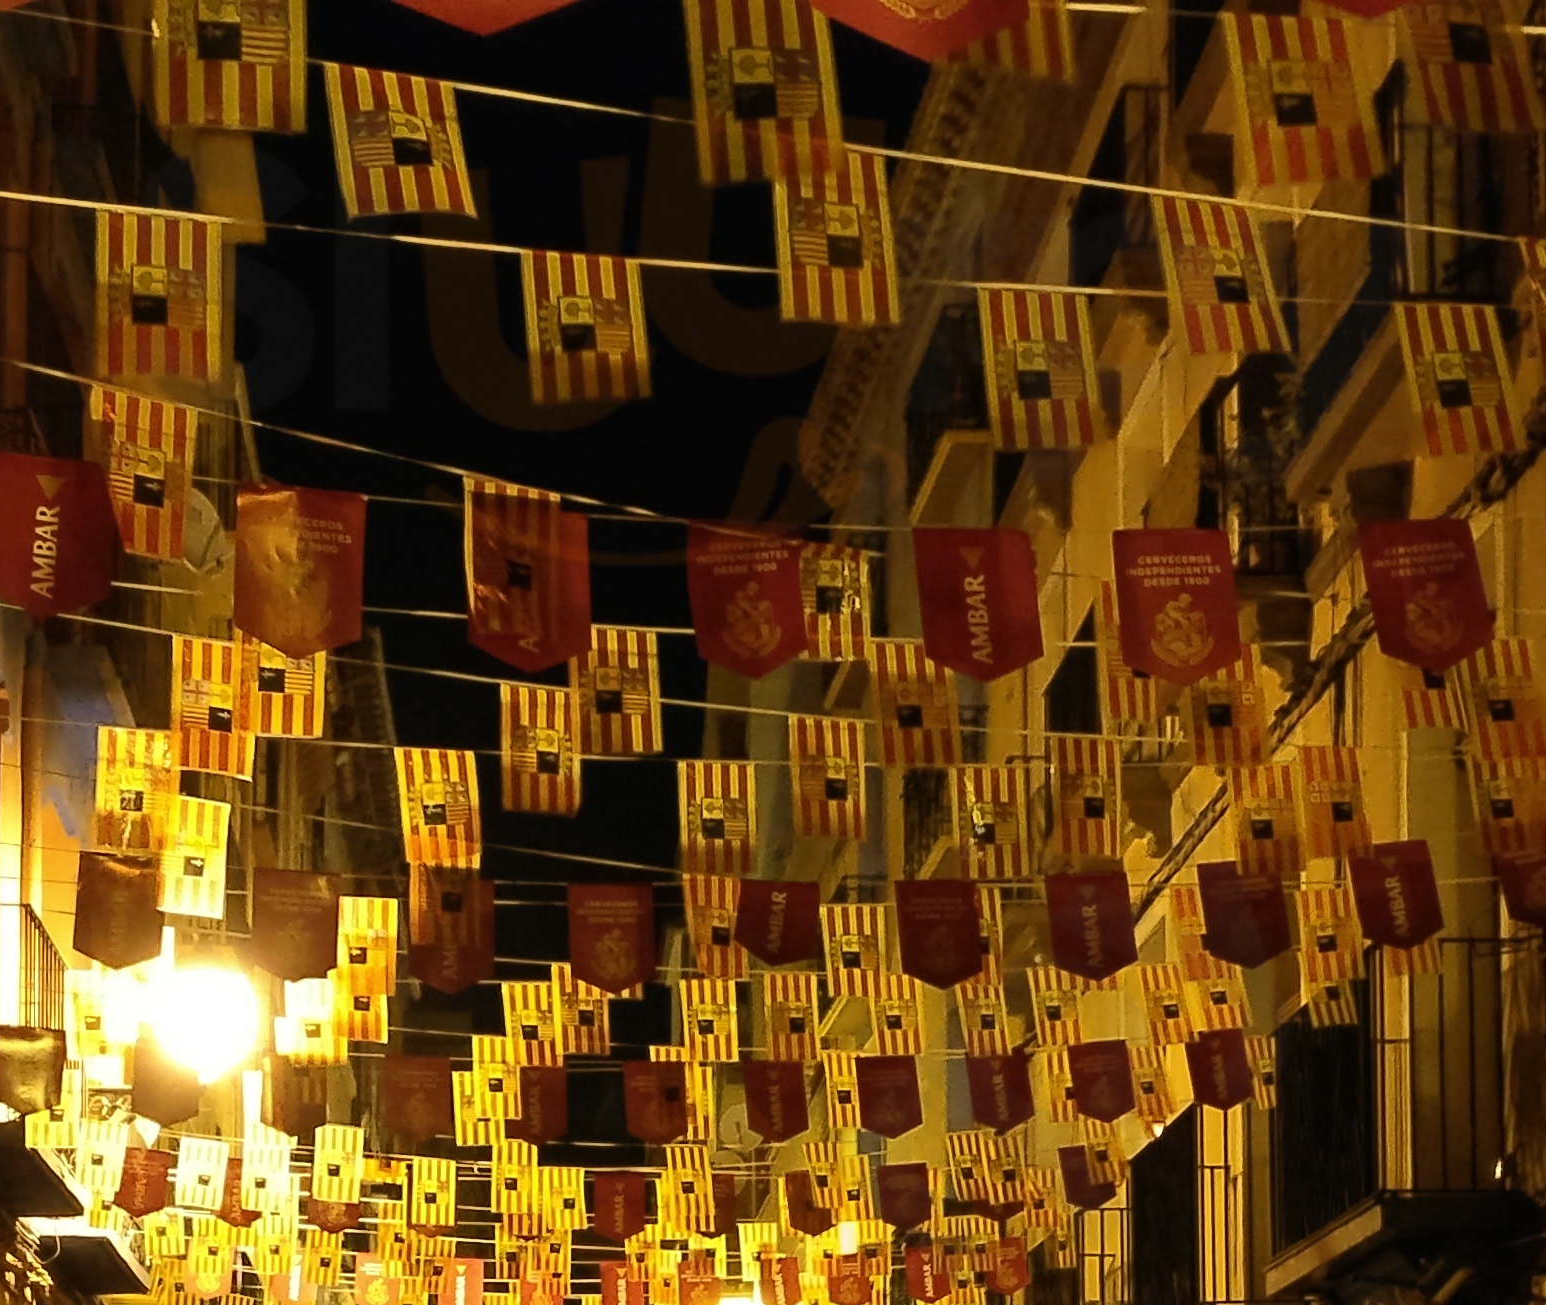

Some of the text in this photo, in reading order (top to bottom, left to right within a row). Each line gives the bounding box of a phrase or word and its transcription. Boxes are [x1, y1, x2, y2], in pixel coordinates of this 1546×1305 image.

[30, 506, 61, 600] AMBAR
[964, 575, 995, 666] AMBAR
[766, 892, 788, 955] AMBAR
[1385, 874, 1411, 938] AMBAR
